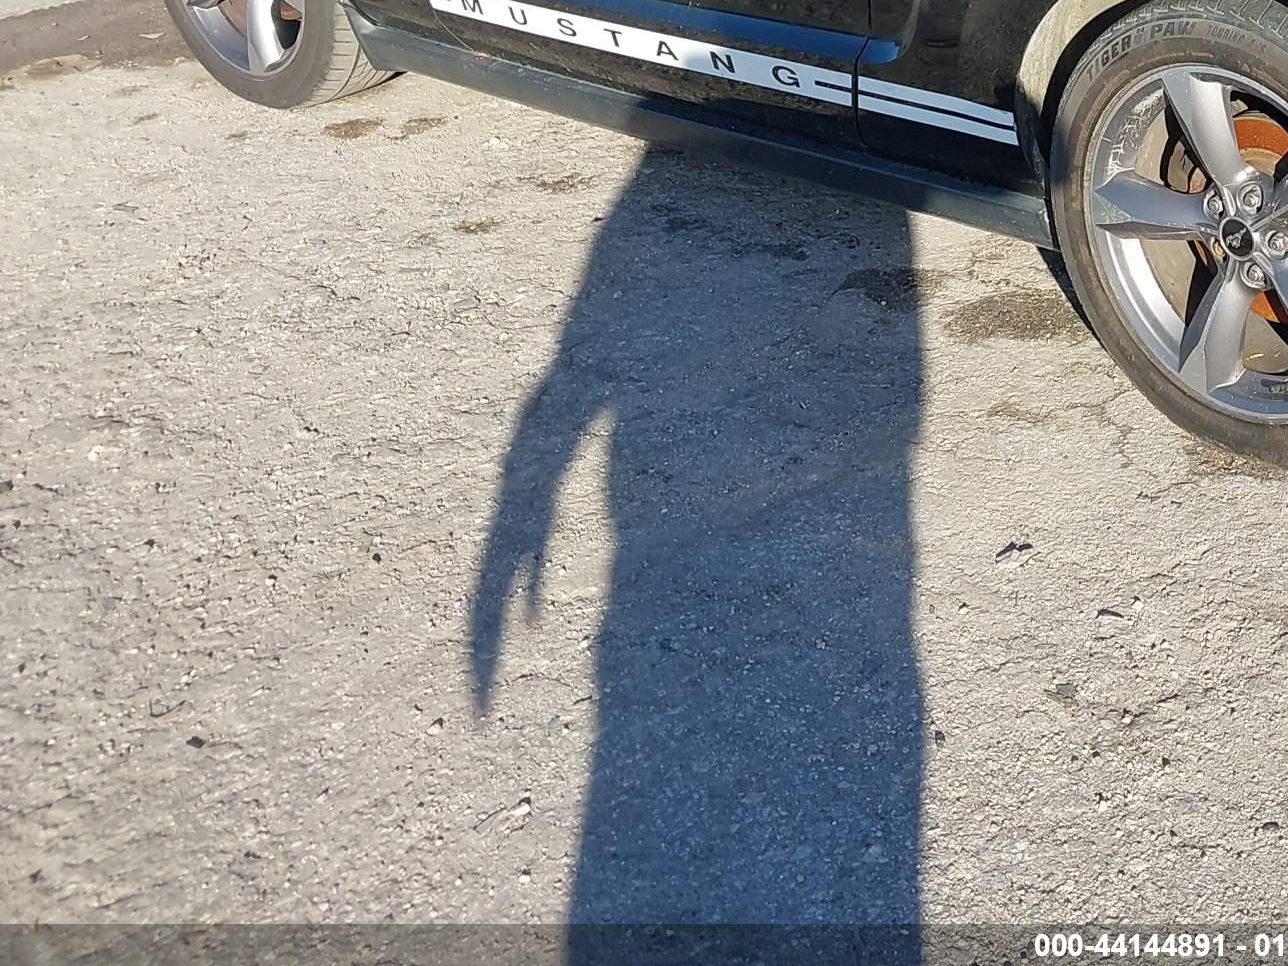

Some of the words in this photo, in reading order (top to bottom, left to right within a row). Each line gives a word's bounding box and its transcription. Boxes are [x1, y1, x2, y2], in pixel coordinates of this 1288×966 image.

[1085, 34, 1132, 83] TIGER
[1150, 20, 1198, 39] PAW
[1207, 24, 1246, 44] TOURING
